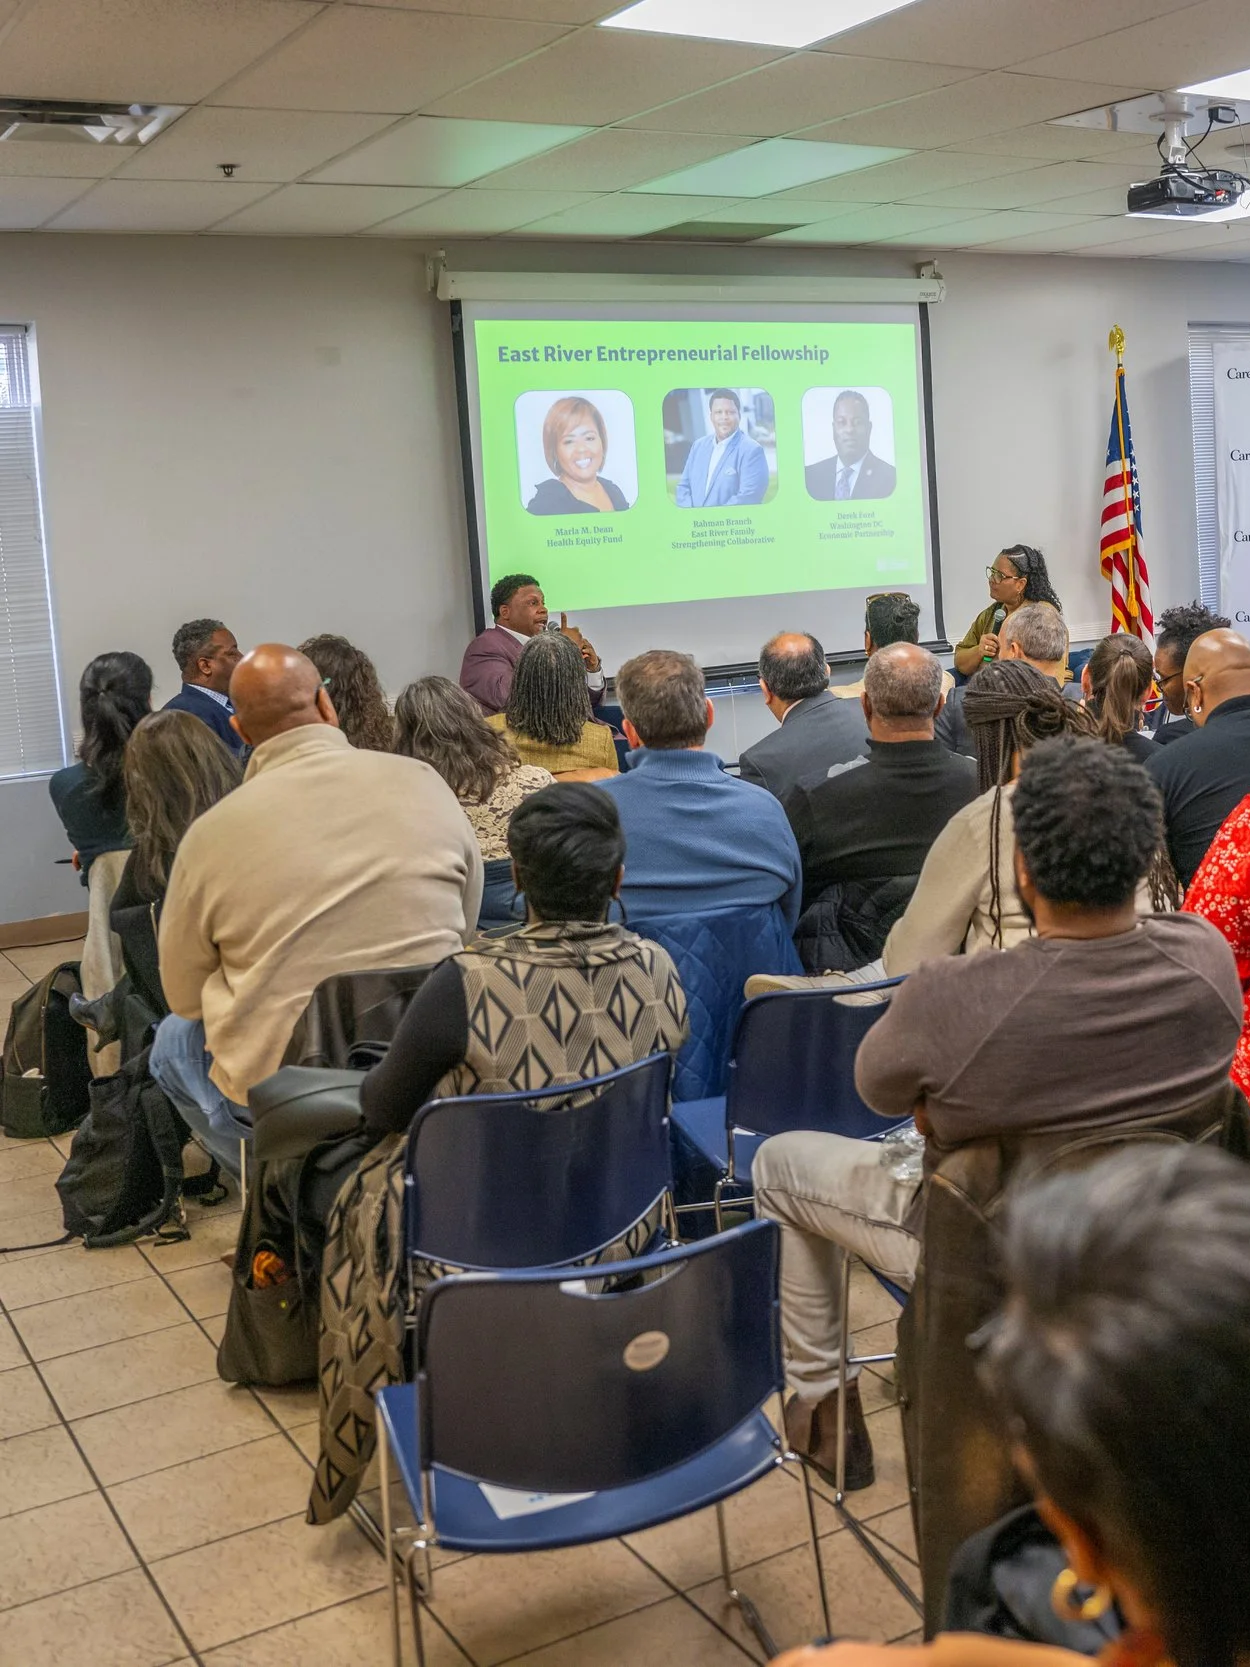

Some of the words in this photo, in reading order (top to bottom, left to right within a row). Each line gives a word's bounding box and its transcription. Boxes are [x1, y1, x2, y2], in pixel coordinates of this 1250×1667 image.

[498, 346, 540, 362] East
[544, 344, 593, 362] River
[597, 344, 738, 366] Entrepreneurial
[742, 344, 829, 365] Fellowship
[693, 519, 725, 528] Rahman
[726, 517, 752, 526] Branch
[593, 526, 614, 534] Dean
[691, 530, 708, 538] East
[709, 528, 729, 537] River
[730, 527, 755, 536] Family
[547, 537, 574, 547] Health
[576, 536, 601, 546] Equity
[603, 535, 623, 543] Fund
[671, 538, 726, 550] Strengthening
[727, 535, 775, 546] Collaborative
